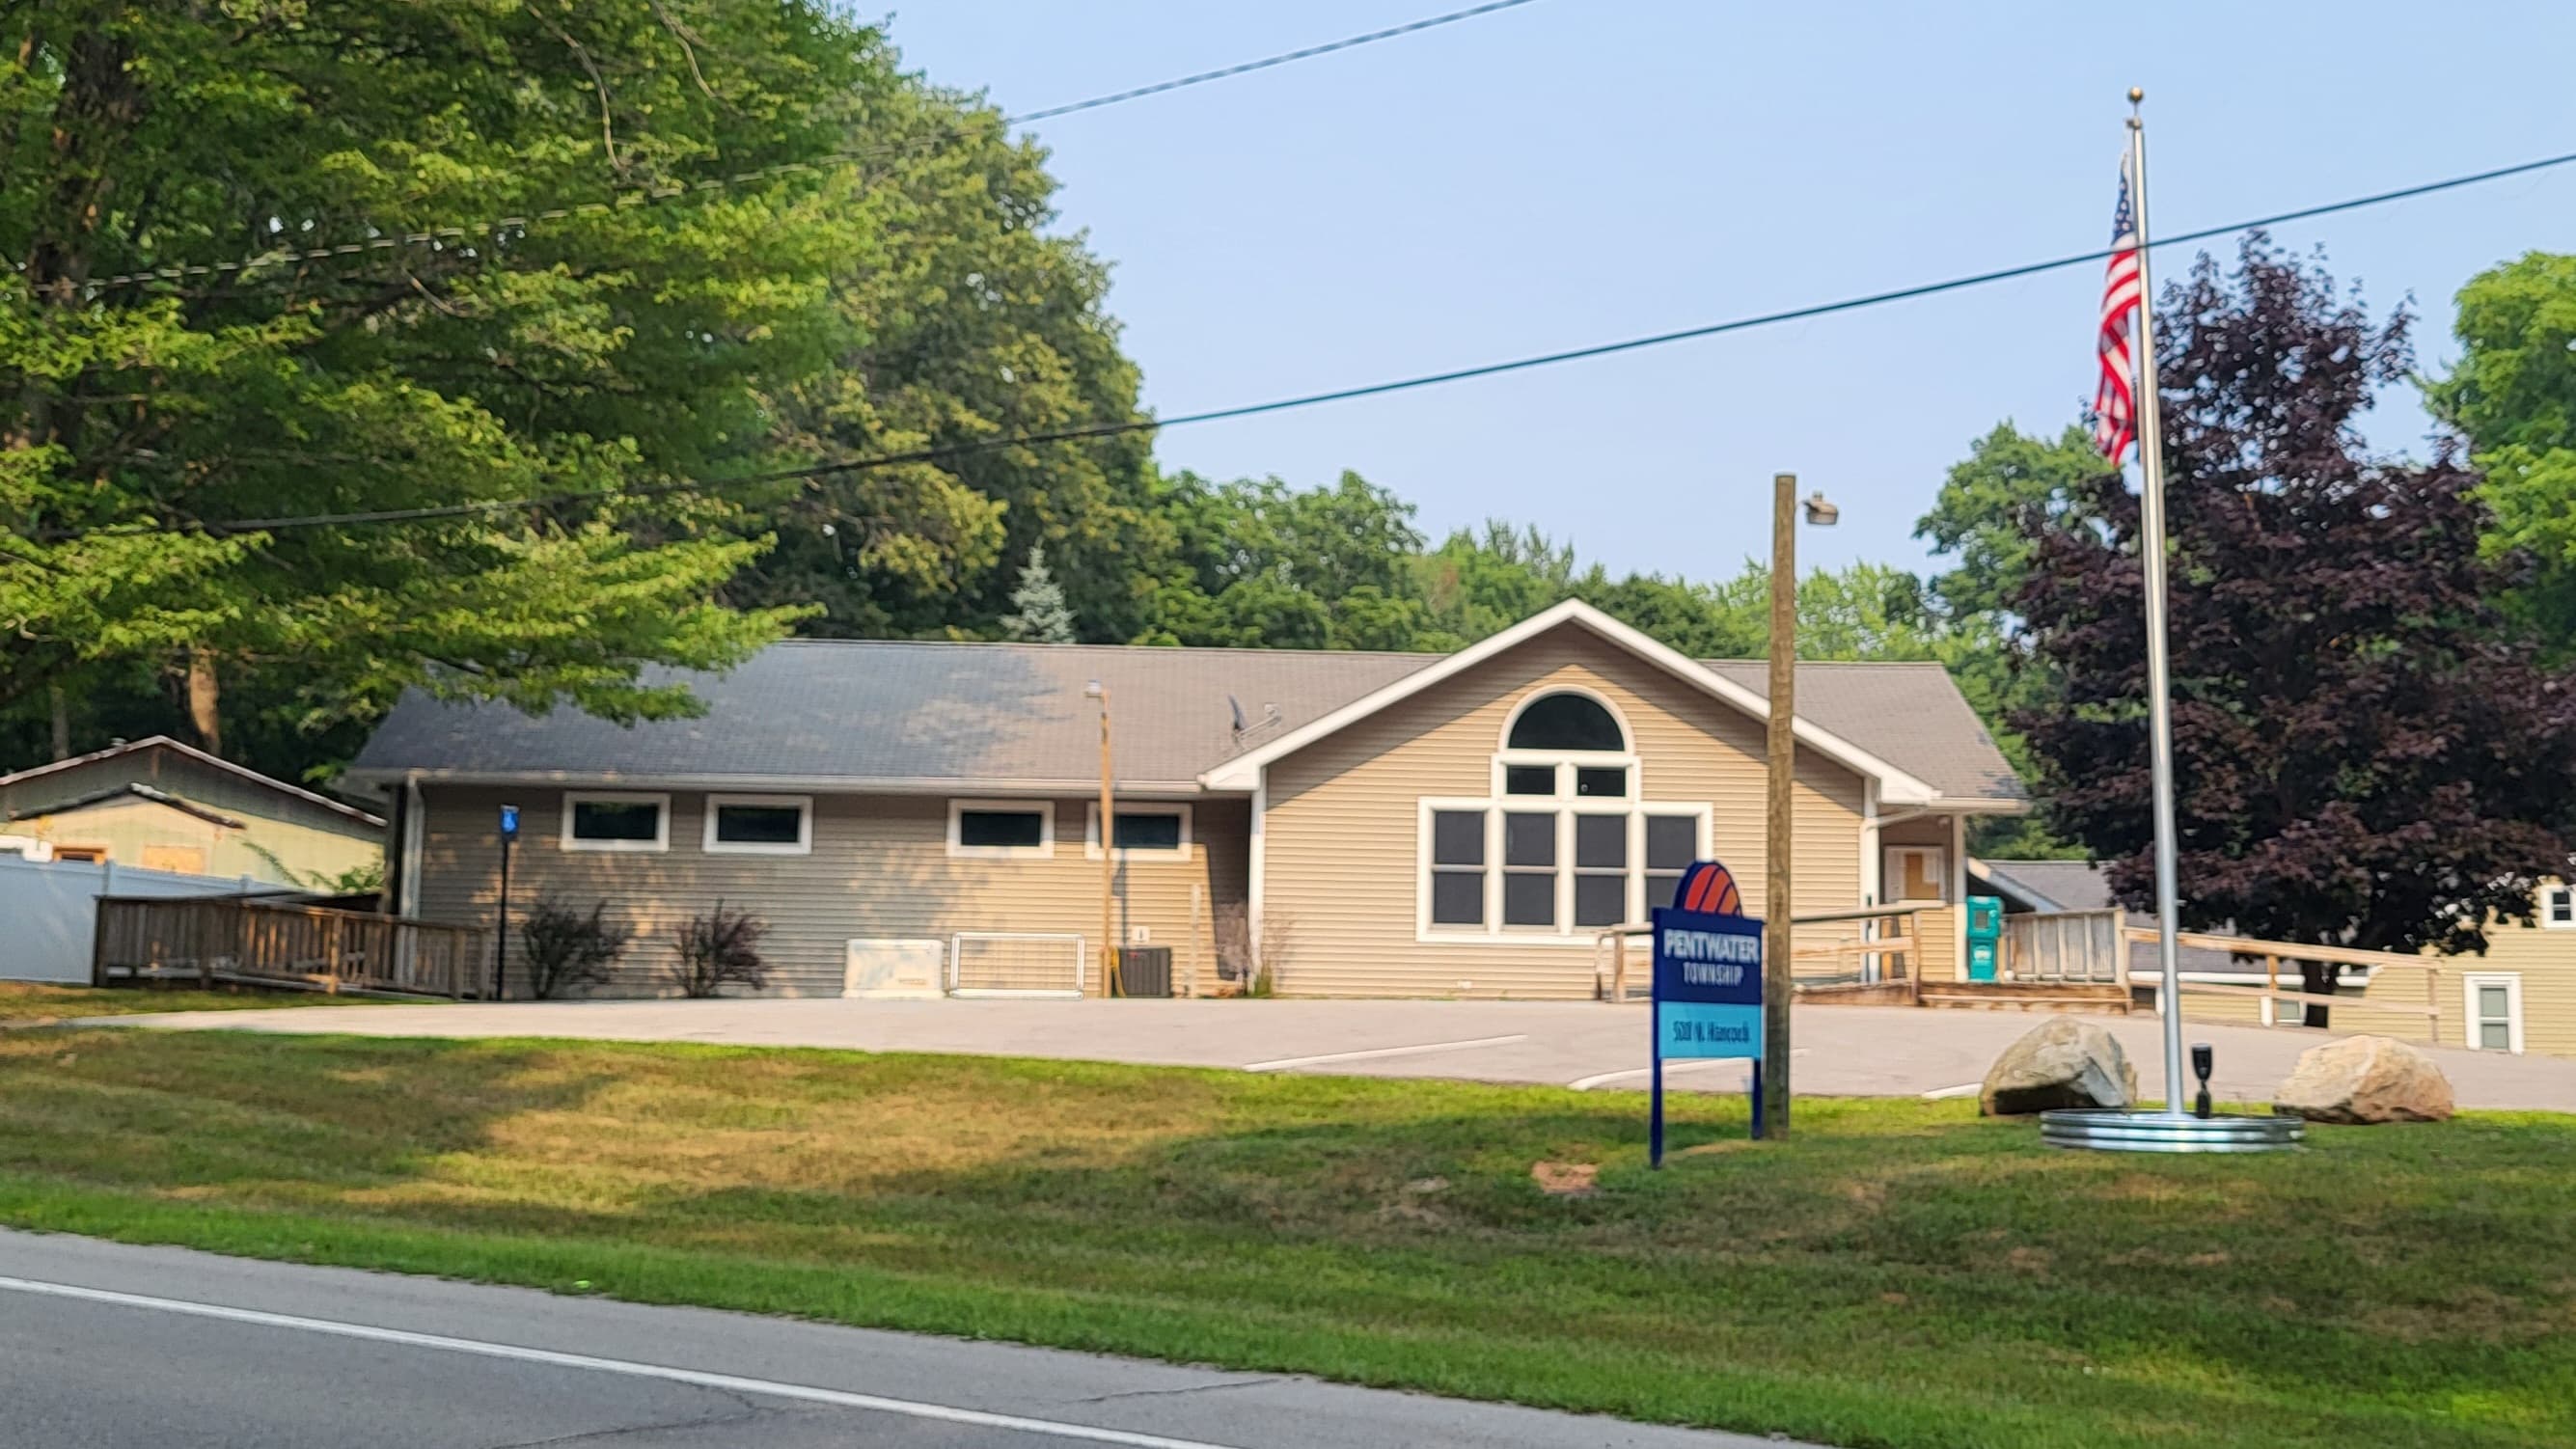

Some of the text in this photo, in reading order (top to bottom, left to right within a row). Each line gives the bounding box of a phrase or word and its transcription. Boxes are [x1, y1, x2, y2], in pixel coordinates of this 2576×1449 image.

[1663, 928, 1760, 965] PENTWATER
[1683, 962, 1743, 987] TOWNSHIP
[1709, 1021, 1750, 1044] Hancock
